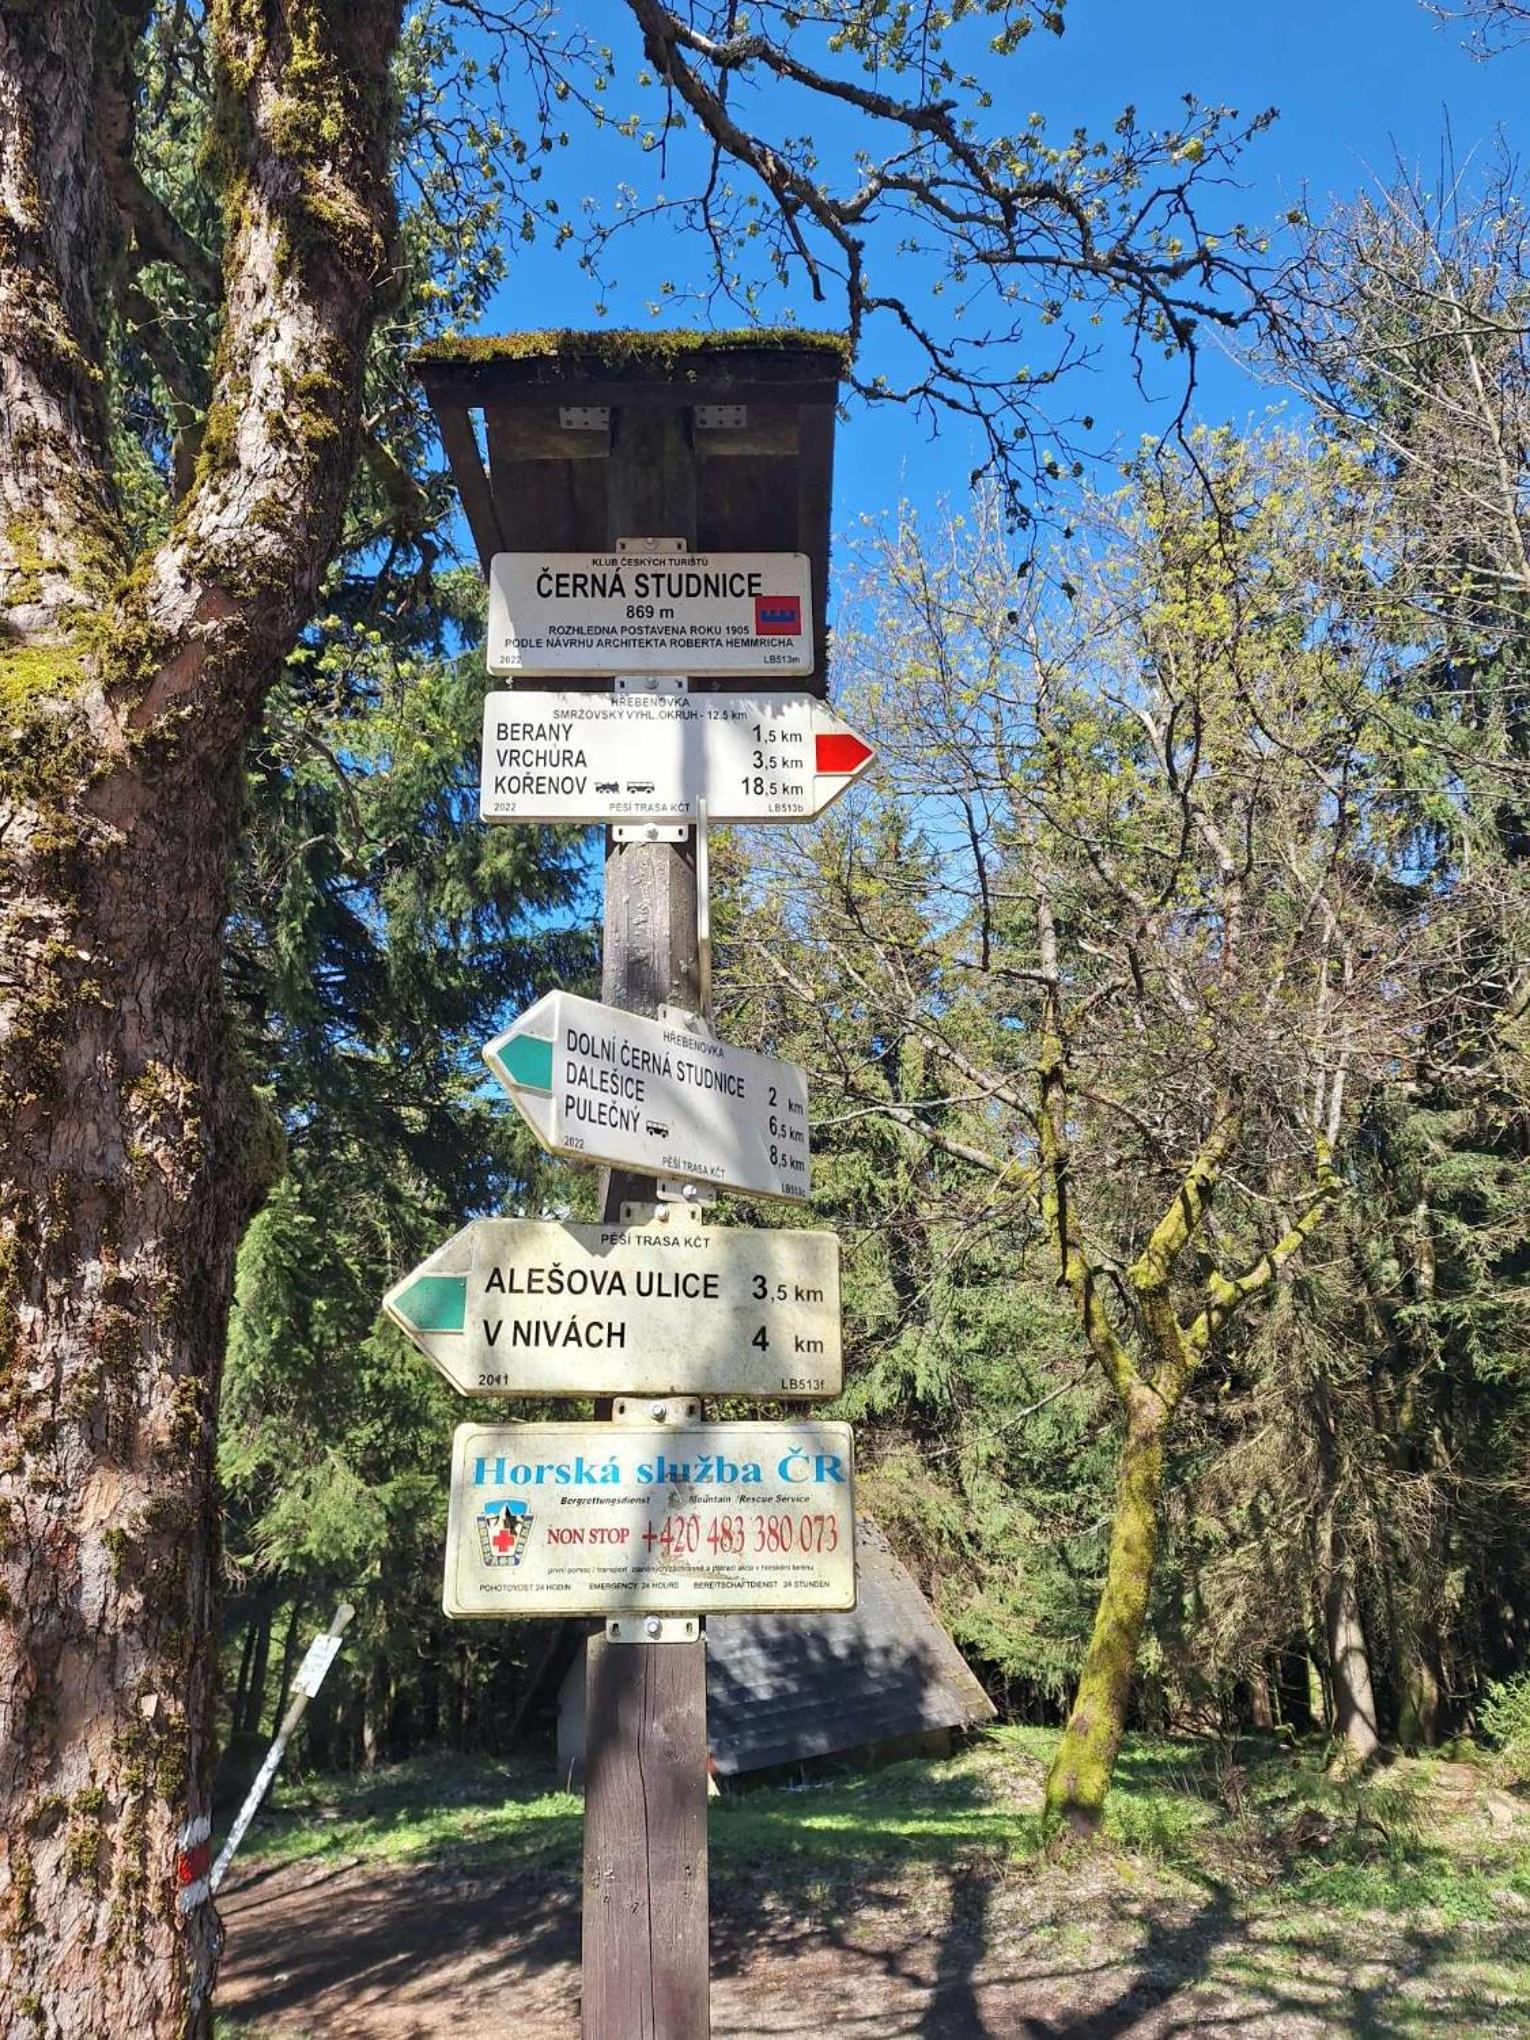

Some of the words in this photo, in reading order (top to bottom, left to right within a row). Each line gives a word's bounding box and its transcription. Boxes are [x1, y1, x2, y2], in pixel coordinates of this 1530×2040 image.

[593, 558, 618, 566] KLUB
[621, 556, 666, 566] ČESKÝCH
[536, 567, 626, 598] ČERNÁ
[634, 573, 762, 598] STUDNICE
[626, 605, 654, 619] 869
[659, 608, 674, 619] m
[549, 625, 617, 635] ROZHLEDNA
[620, 625, 689, 635] POSTAVENA
[690, 625, 722, 635] ROKU
[725, 625, 749, 635] 1905
[505, 638, 543, 648] PODLE
[546, 636, 594, 648] NÁVRHU
[595, 638, 667, 648] ARCHITEKTA
[669, 638, 723, 648] ROBERTA
[726, 638, 794, 648] HEMMRICHA
[500, 655, 522, 664] 2022
[763, 655, 800, 664] LB513m
[659, 710, 697, 720] OKRUH
[731, 709, 748, 720] km
[497, 722, 573, 741] BERANY
[752, 724, 776, 745] 1,5
[781, 730, 802, 743] km
[753, 750, 777, 771] 3,5
[782, 757, 803, 769] km
[494, 771, 587, 795] KOŘENOV
[782, 783, 803, 795] km
[494, 803, 516, 812] 2022
[635, 803, 668, 812] TRASA
[671, 801, 690, 812] KČT
[567, 1029, 616, 1063] DOLNÍ
[620, 1039, 672, 1078] ČERNÁ
[676, 1060, 745, 1098] STUDNICE
[768, 1087, 777, 1106] 2
[788, 1098, 804, 1115] km
[566, 1061, 645, 1102] DALEŠICE
[769, 1116, 787, 1139] 6,5
[789, 1127, 804, 1143] km
[565, 1094, 640, 1133] PULEČNÝ
[769, 1144, 787, 1169] 8,5
[789, 1156, 806, 1172] km
[564, 1135, 584, 1150] 2022
[682, 1160, 709, 1175] TRASA
[600, 1231, 631, 1246] PĚŠÍ
[636, 1234, 680, 1248] TRASA
[684, 1234, 711, 1249] KČT
[484, 1262, 627, 1296] ALEŠOVA
[636, 1271, 719, 1299] ULICE
[752, 1274, 787, 1304] 3,5
[795, 1285, 824, 1302] km
[483, 1319, 503, 1347] V
[513, 1315, 626, 1349] NIVÁCH
[752, 1326, 769, 1351] 4
[795, 1335, 824, 1354] km
[781, 1378, 825, 1391] LB513f
[473, 1455, 620, 1485] Horská
[637, 1454, 763, 1485] služba
[777, 1446, 846, 1484] ČR
[689, 1494, 731, 1504] Mountain
[739, 1494, 773, 1504] Rescue
[775, 1494, 810, 1504] Service
[547, 1528, 583, 1545] NON
[588, 1528, 630, 1545] STOP
[642, 1515, 700, 1557] +420
[707, 1514, 745, 1555] 483
[753, 1514, 793, 1553] 380
[800, 1514, 838, 1553] 073
[546, 1583, 571, 1591] HODIN
[588, 1582, 637, 1591] EMERGENCY
[640, 1581, 650, 1590] 24
[794, 1580, 831, 1588] STUNDEN
